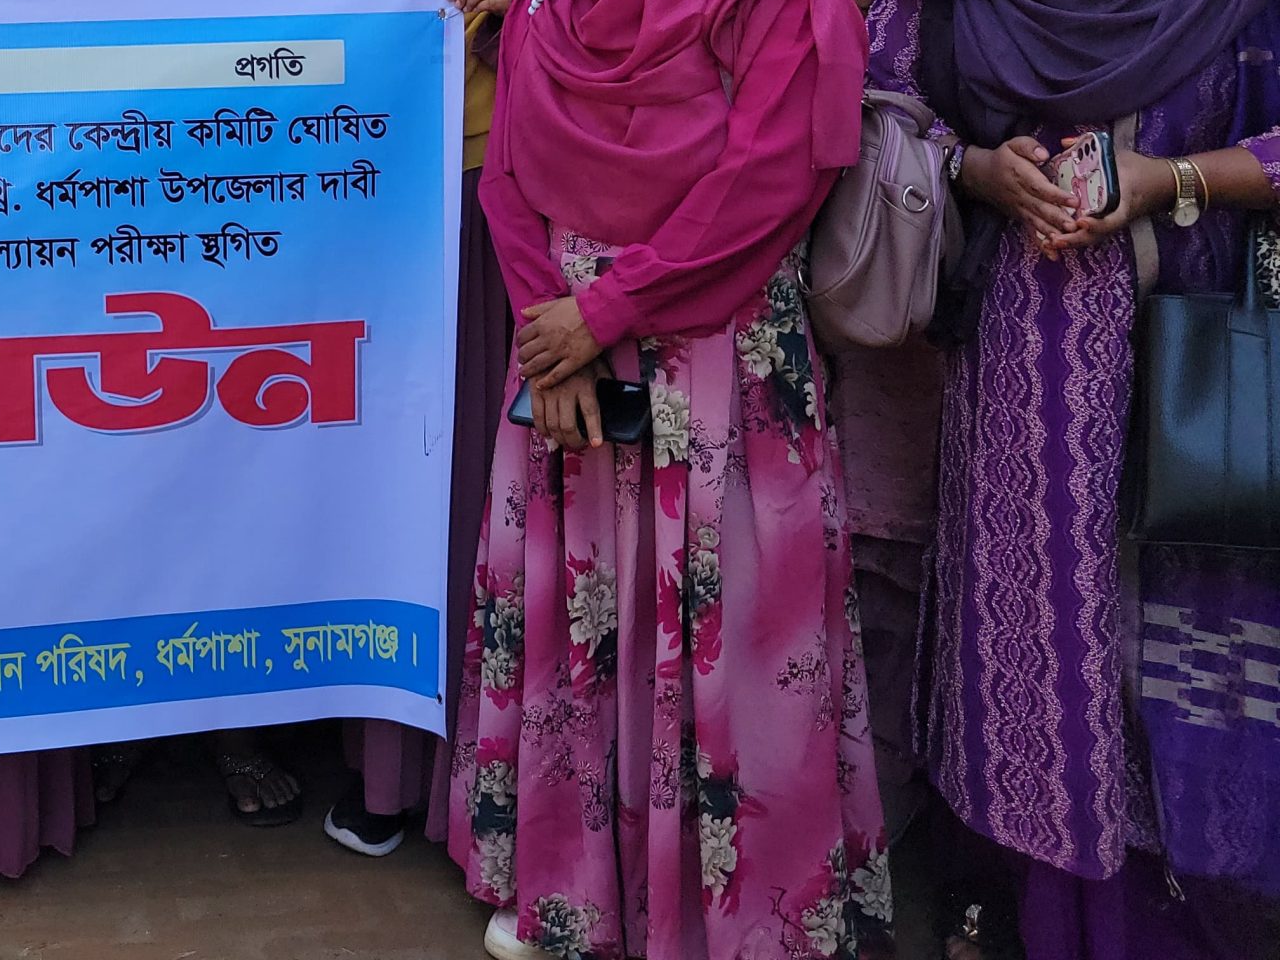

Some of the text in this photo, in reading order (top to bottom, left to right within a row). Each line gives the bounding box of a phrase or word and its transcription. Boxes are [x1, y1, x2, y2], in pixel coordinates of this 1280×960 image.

[235, 48, 306, 81] প্রগতি
[65, 109, 175, 154] কেন্দ্রীয়
[186, 108, 278, 147] কমিটি
[288, 105, 390, 144] ঘোষিত
[36, 168, 149, 210] ধর্মপাশা
[158, 168, 308, 204] উপজেলার
[316, 159, 381, 200] দাবী
[91, 225, 190, 266] পরীক্ষা
[196, 222, 282, 268] স্থগিত
